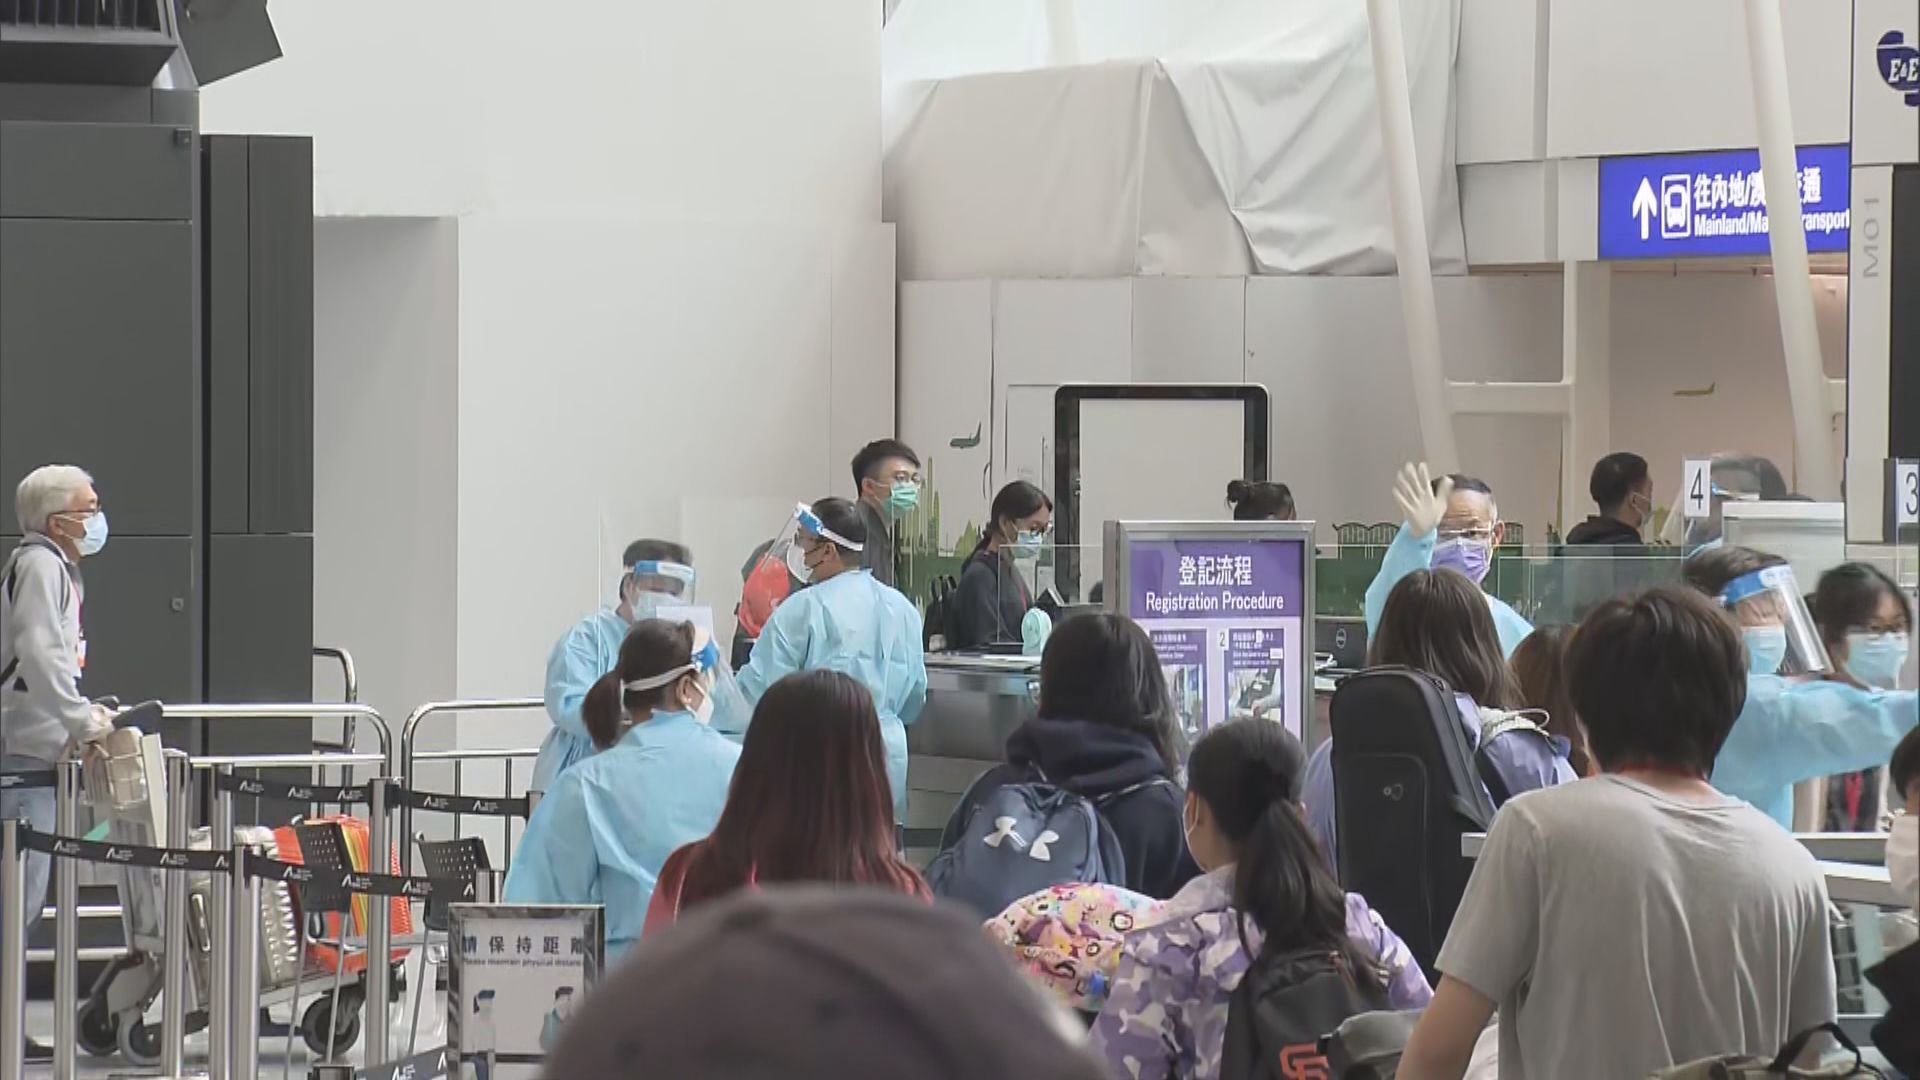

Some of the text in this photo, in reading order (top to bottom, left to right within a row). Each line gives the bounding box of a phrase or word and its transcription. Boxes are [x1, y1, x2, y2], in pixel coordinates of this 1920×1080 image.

[1694, 166, 1821, 210] 往內地/澳通
[1694, 208, 1849, 237] Mainland/Ma ransport
[1690, 467, 1704, 510] 4
[1906, 472, 1919, 515] 3
[1178, 555, 1252, 585] 登記流程
[1146, 590, 1284, 614] Registration Procedure
[1219, 632, 1226, 647] 2
